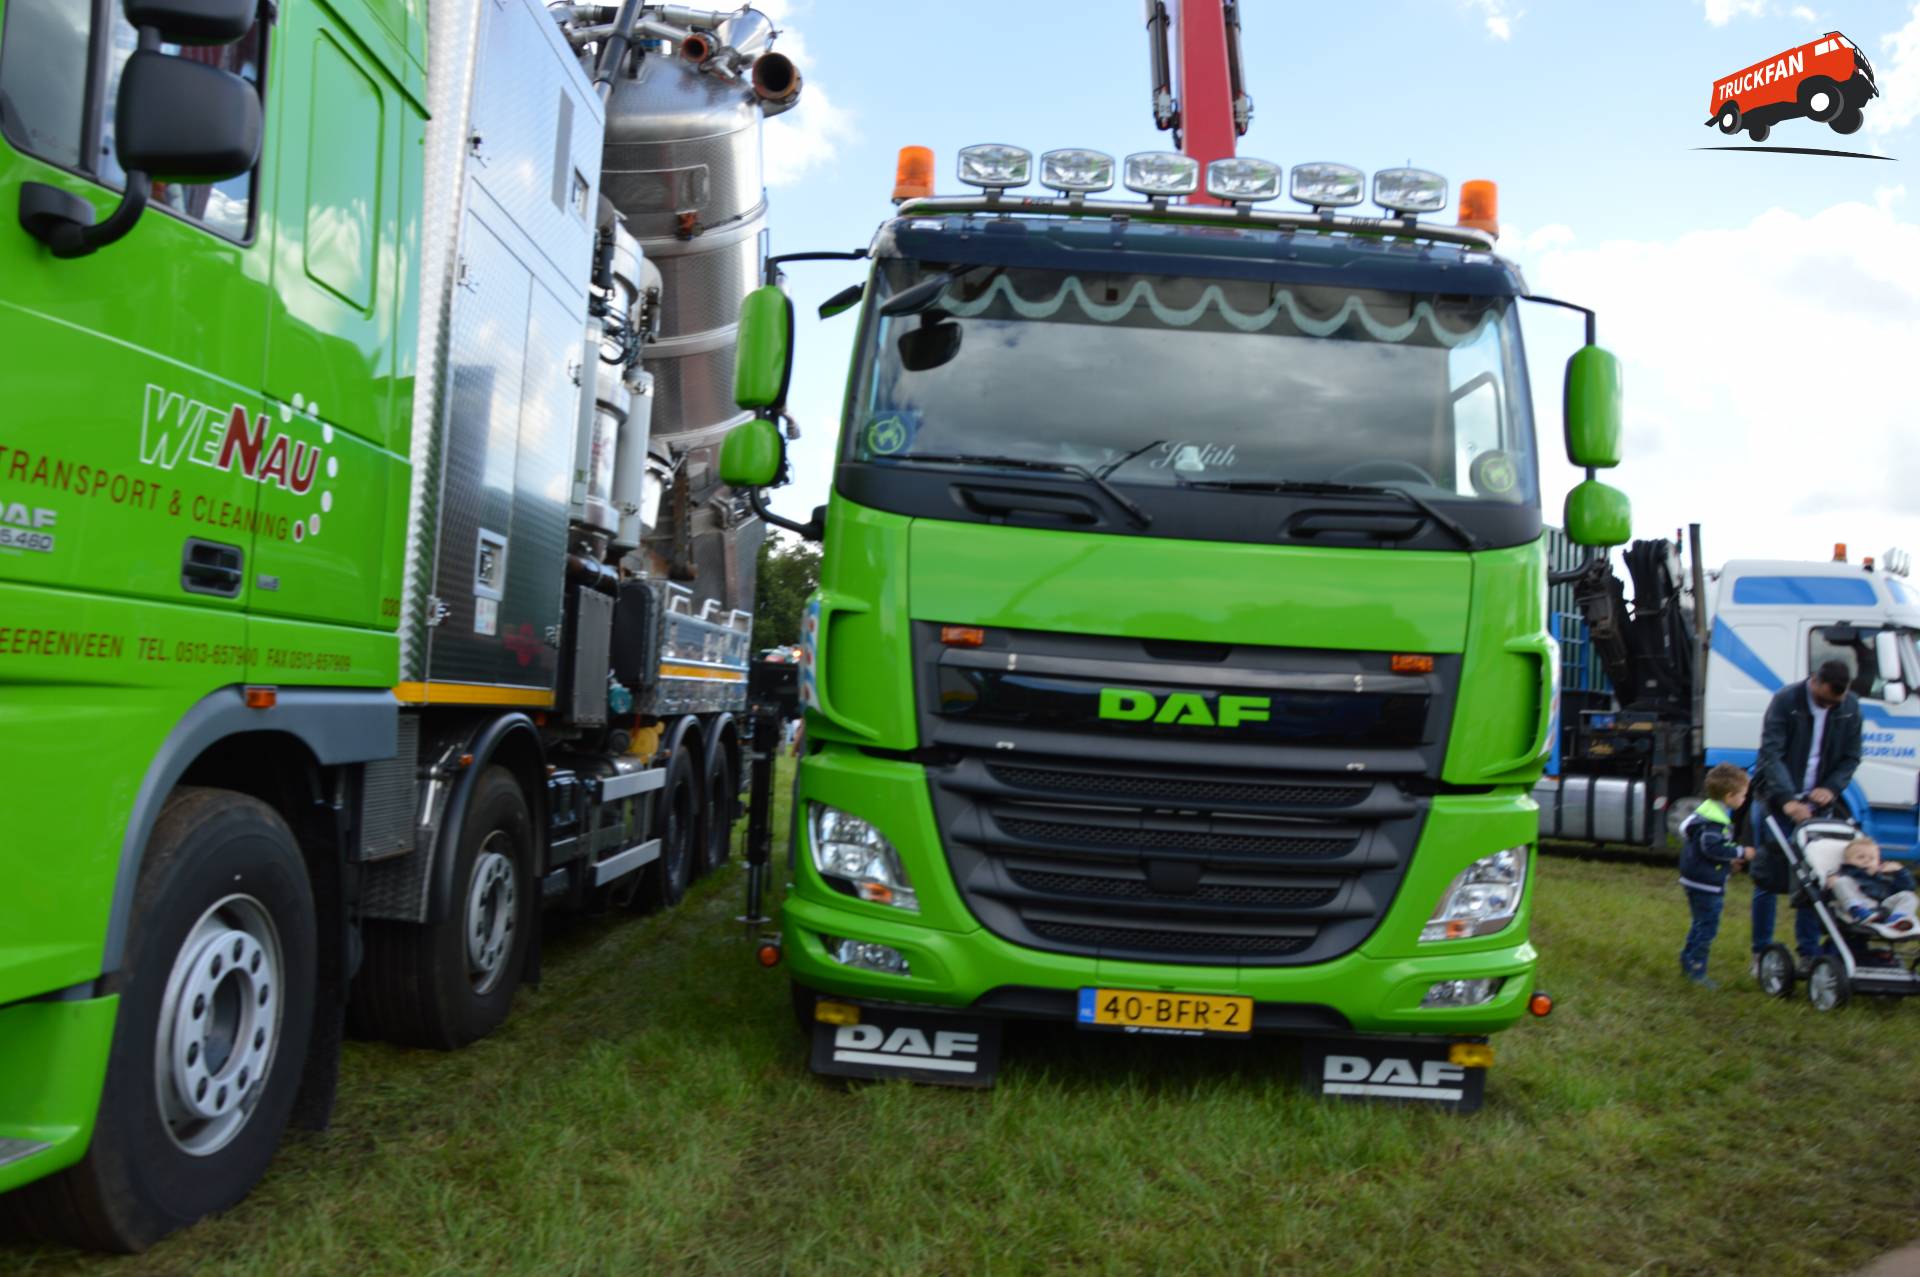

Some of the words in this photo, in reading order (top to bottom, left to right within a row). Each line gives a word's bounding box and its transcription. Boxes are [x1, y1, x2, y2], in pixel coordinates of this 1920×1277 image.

[140, 383, 321, 495] WENAU
[0, 500, 57, 529] AF
[168, 489, 182, 516] &
[192, 495, 288, 541] CLEANING
[138, 636, 171, 662] TEL.
[1098, 687, 1271, 727] DAF
[1104, 996, 1240, 1026] 40-BFR-2
[834, 1024, 979, 1057] DAF
[1323, 1055, 1465, 1086] DAF
